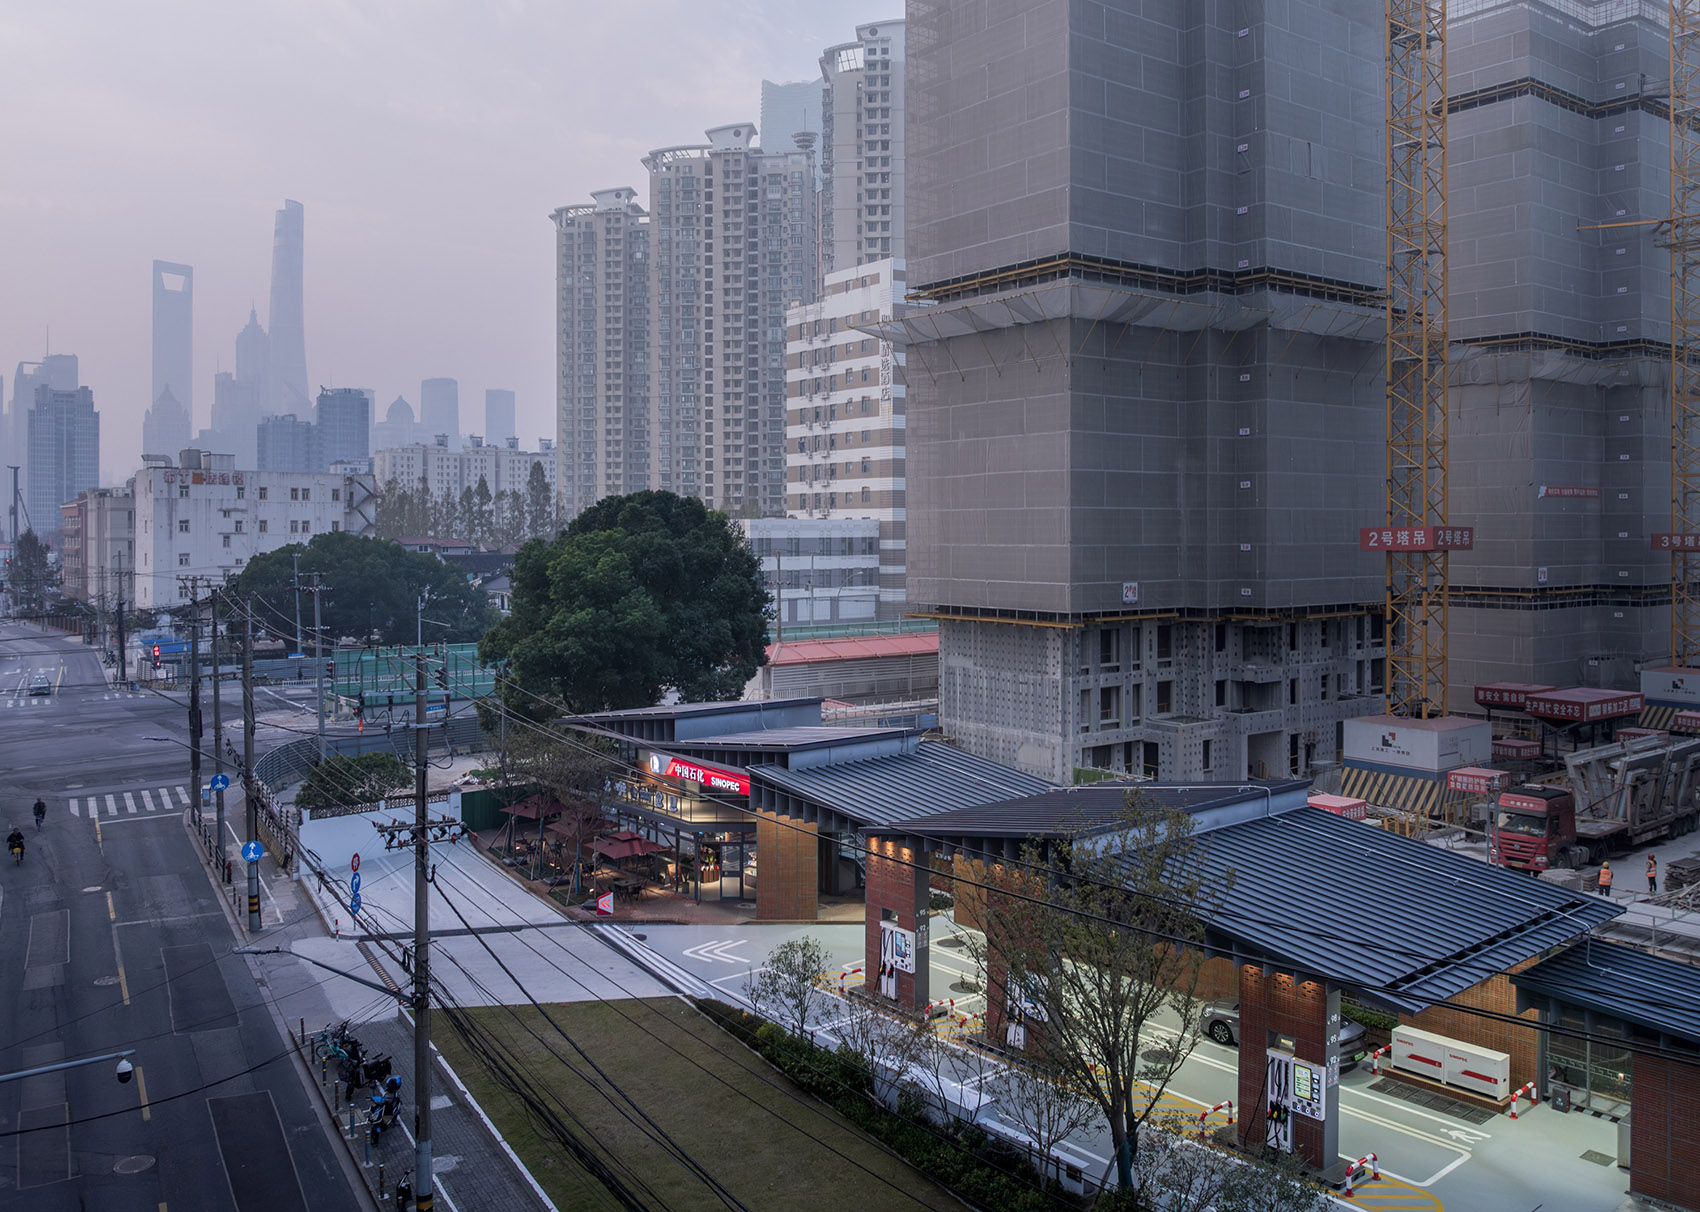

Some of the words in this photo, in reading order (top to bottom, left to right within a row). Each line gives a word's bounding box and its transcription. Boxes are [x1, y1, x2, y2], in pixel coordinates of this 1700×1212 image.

[1368, 530, 1426, 547] 2号塔吊
[1437, 530, 1470, 546] 2号塔吊
[1661, 535, 1700, 548] 3号塔
[1525, 700, 1552, 714] 生产再忙
[1553, 703, 1581, 718] 安全不忘
[674, 763, 705, 783] 中国石化
[711, 776, 740, 792] SINOPEC
